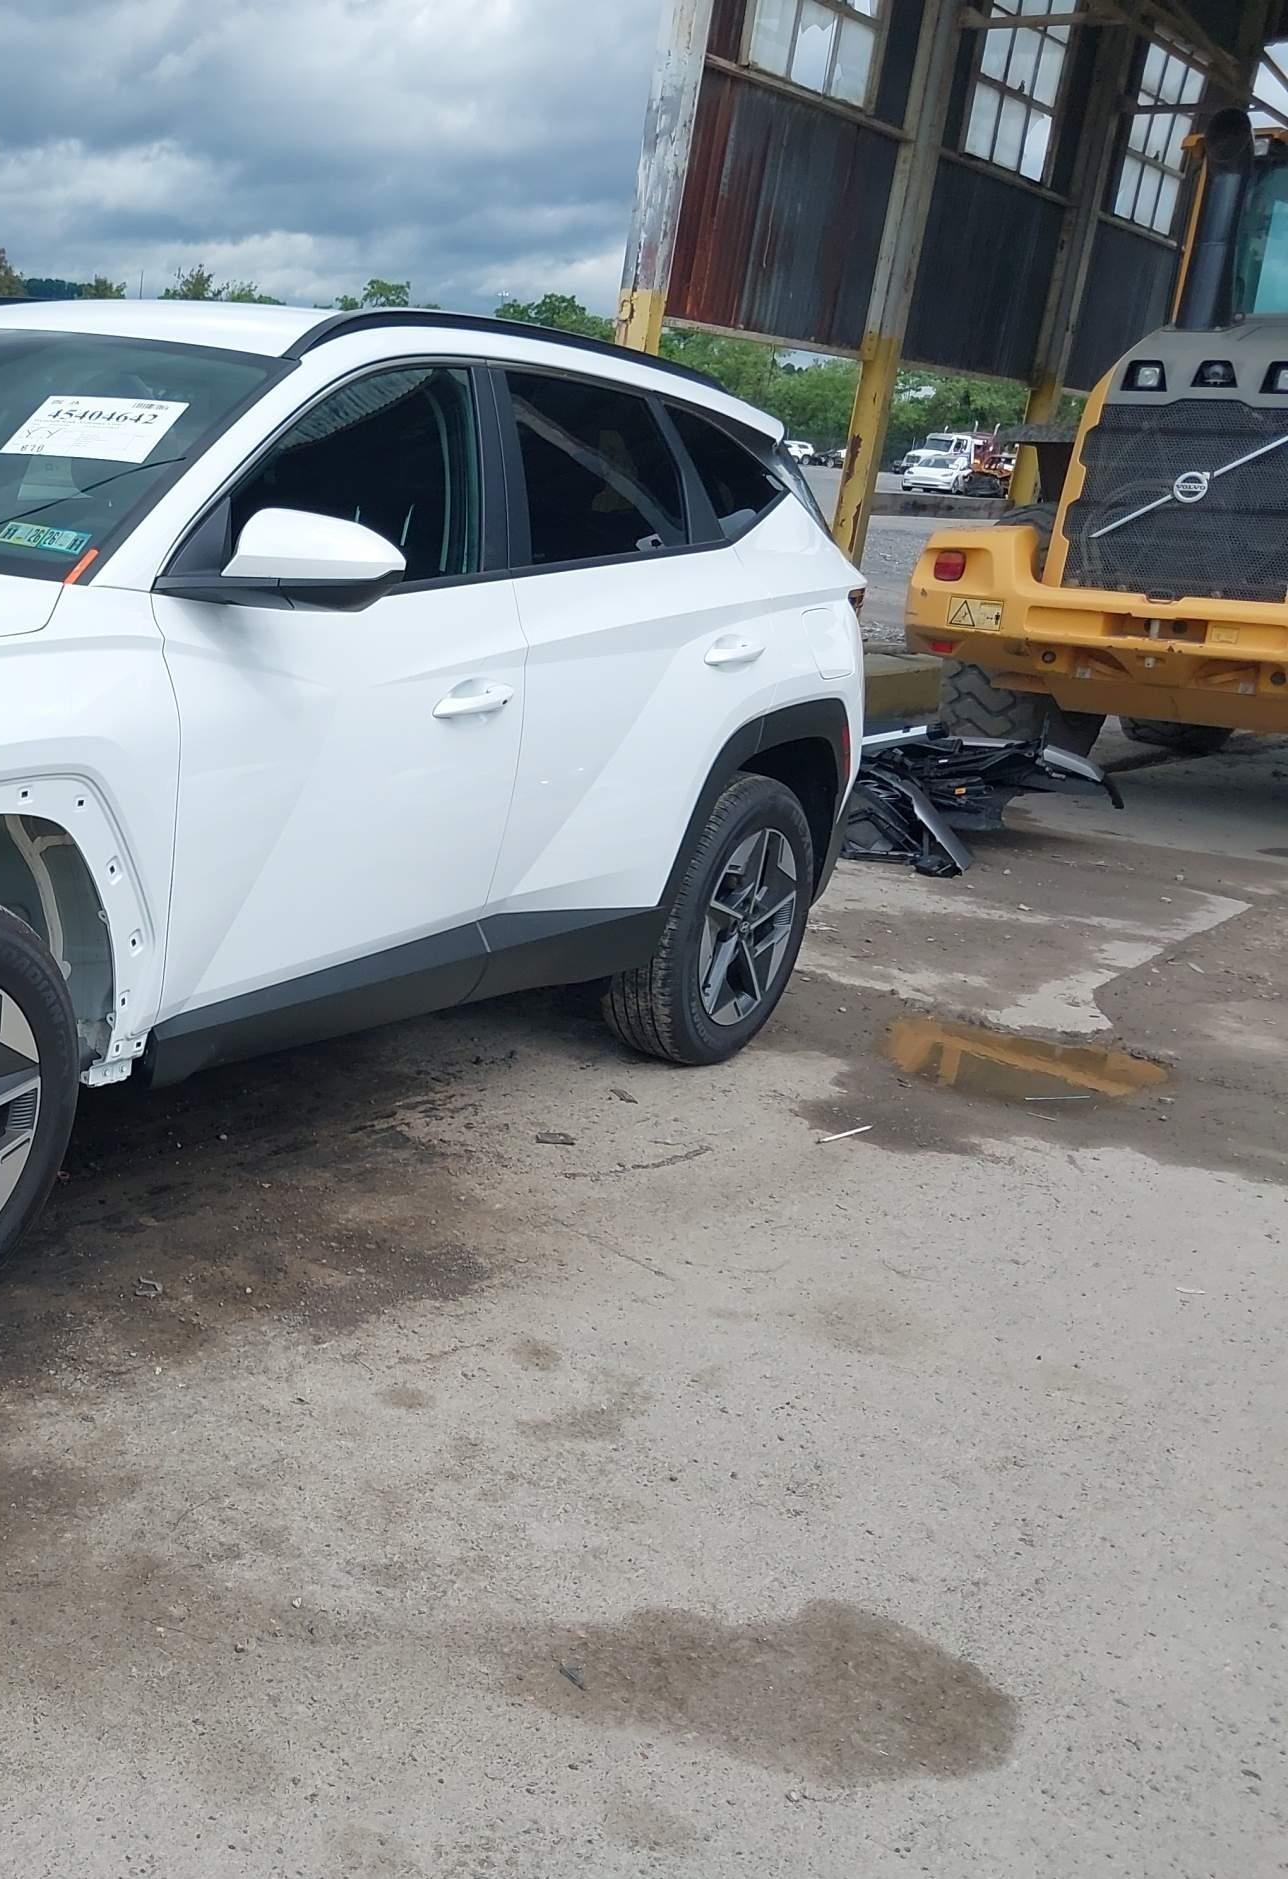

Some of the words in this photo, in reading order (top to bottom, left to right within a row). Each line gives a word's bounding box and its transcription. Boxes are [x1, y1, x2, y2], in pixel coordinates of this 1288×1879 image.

[48, 408, 159, 425] 45404642
[27, 528, 45, 543] 26
[43, 530, 60, 546] 26
